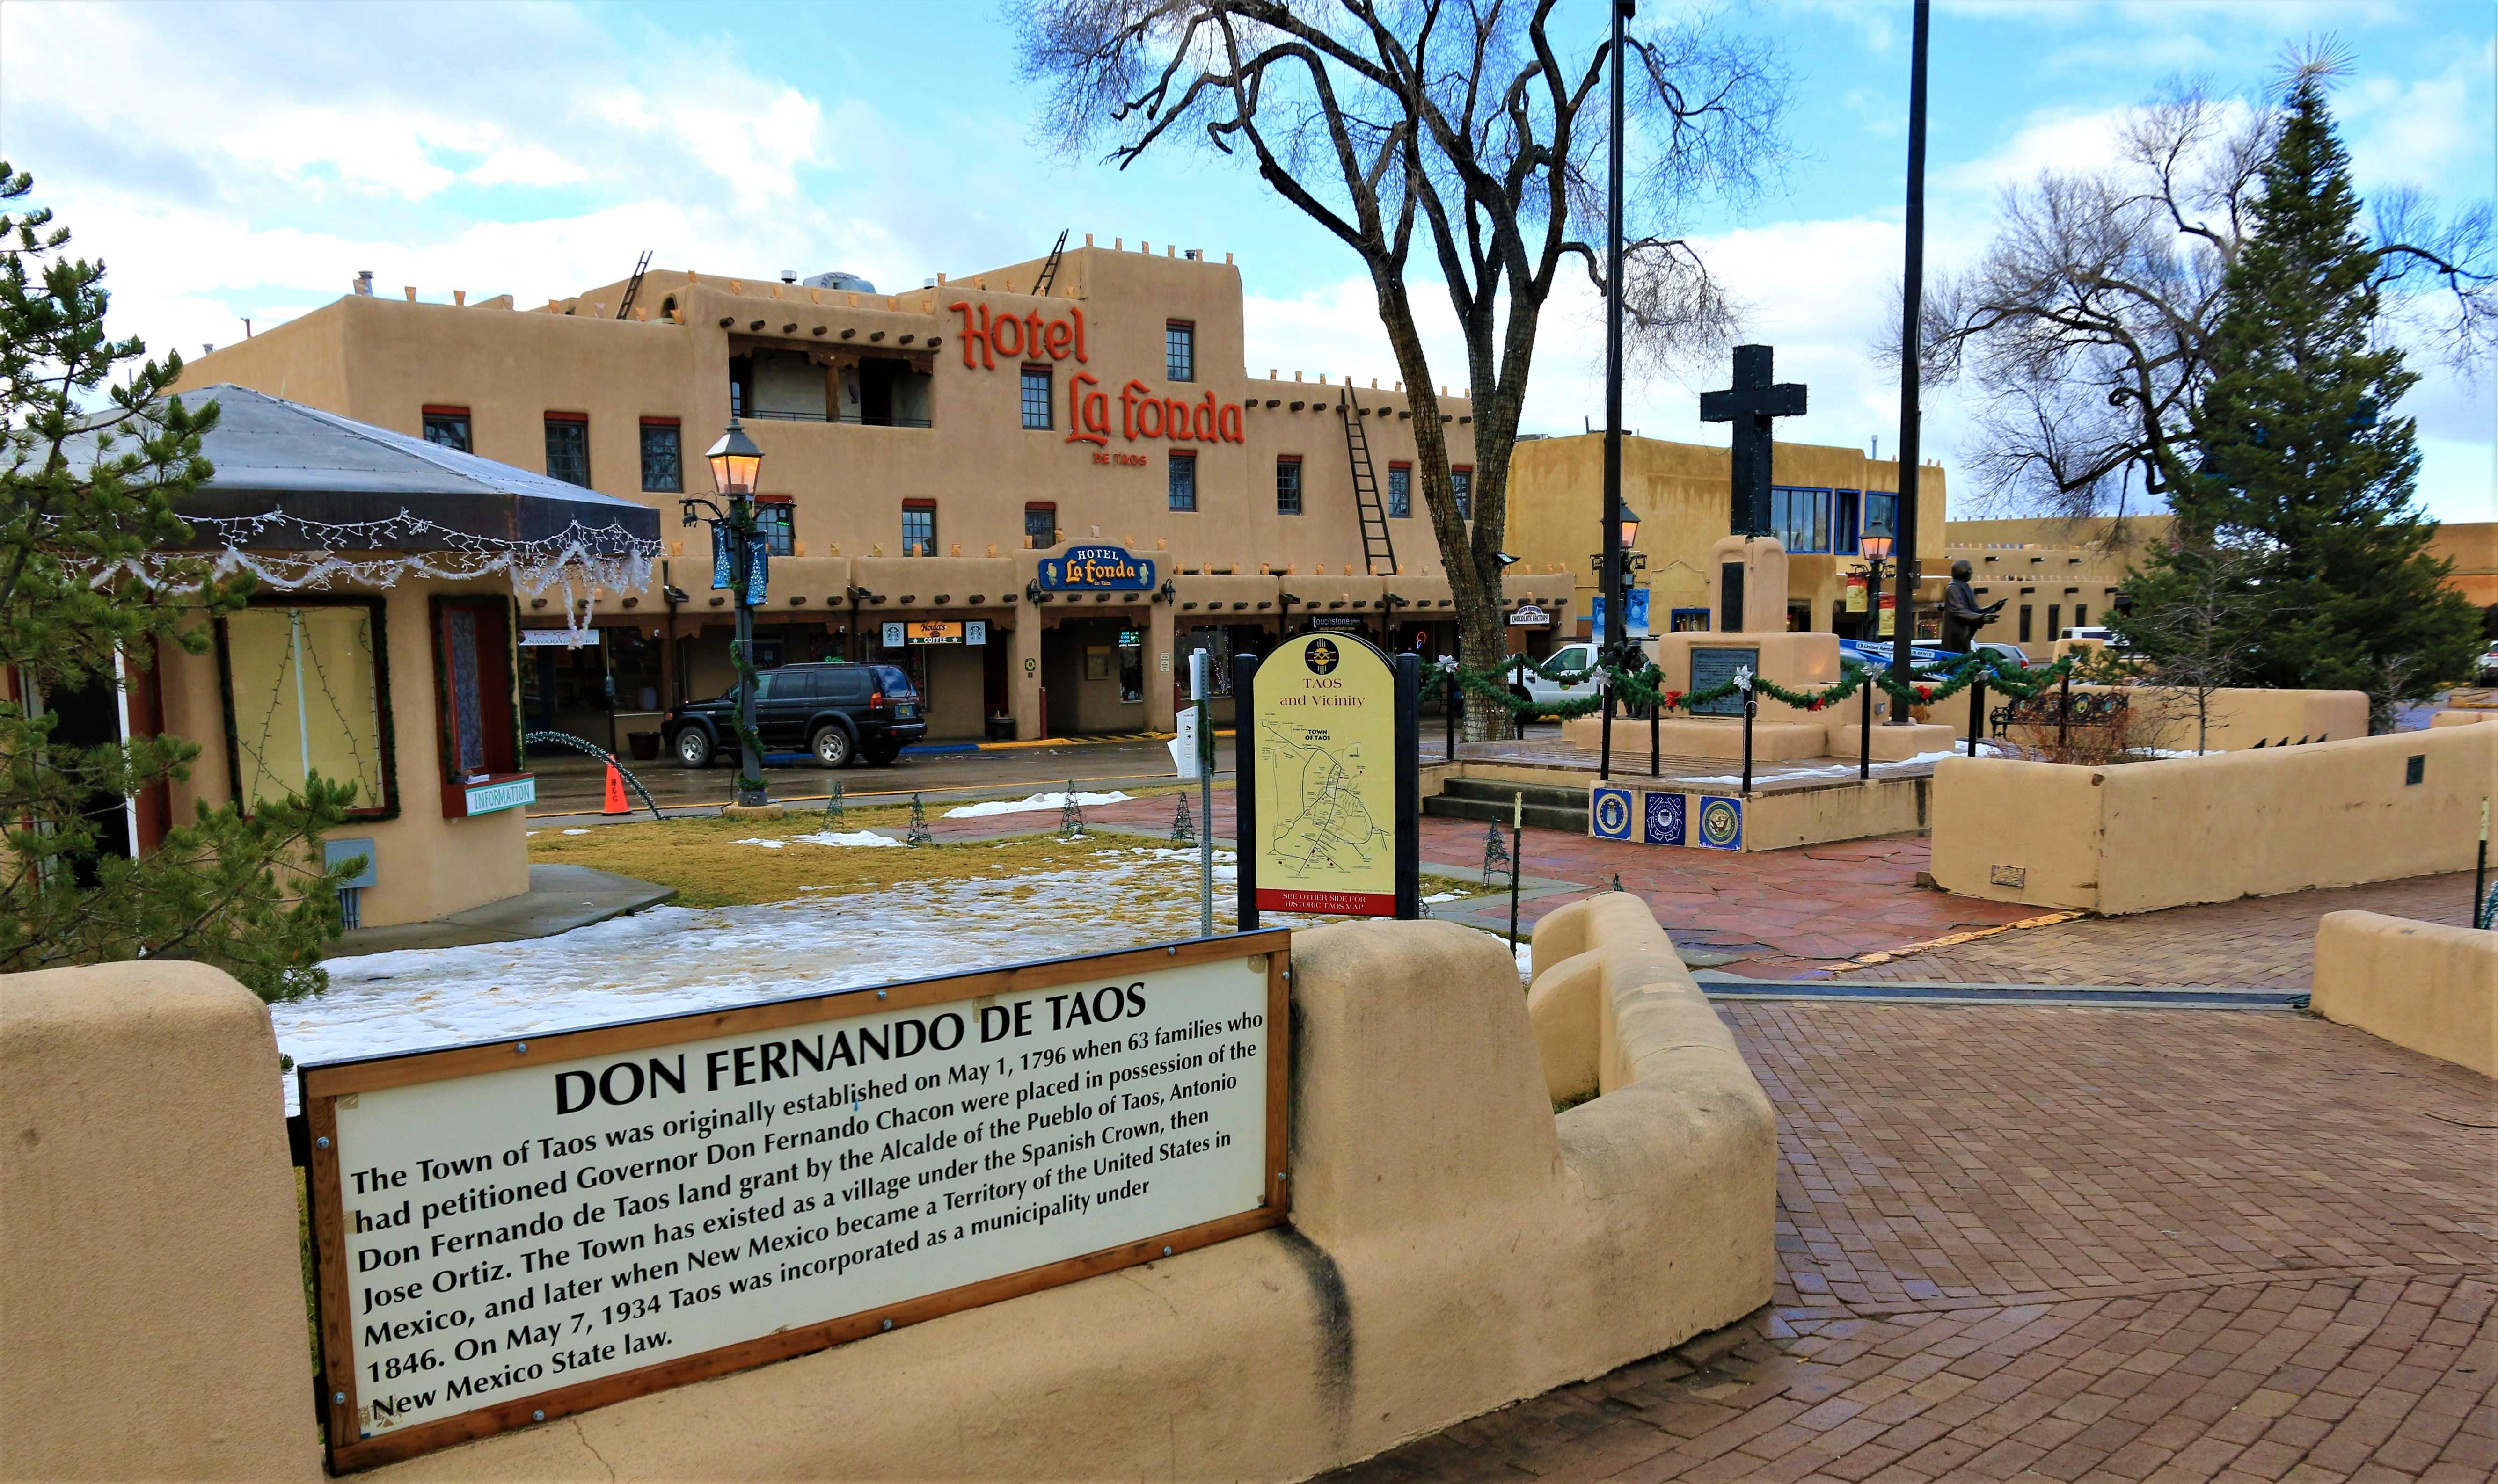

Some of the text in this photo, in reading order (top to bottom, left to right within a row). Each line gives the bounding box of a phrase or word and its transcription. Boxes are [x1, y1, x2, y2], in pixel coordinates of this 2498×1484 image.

[949, 301, 1088, 370] Hotel
[1066, 372, 1111, 446] La
[1093, 453, 1110, 465] DE
[1065, 559, 1083, 583] La
[1077, 549, 1119, 560] HOTEL
[1313, 616, 1350, 627] touchstone
[1280, 695, 1365, 708] and Vicinity
[1303, 678, 1342, 689] TAOS
[474, 784, 530, 809] INFORMATION
[554, 981, 1146, 1116] DON FERNANDO DE TAOS
[350, 1011, 1263, 1194] The Town of Taos was originally established on May 1, 1796 when 63 families who
[355, 1041, 1256, 1234] had petitioned Governor Don Fernando Chacon were placed in possession of the
[358, 1077, 1237, 1273] Don Fernando de Taos land grant by the Alcalde of the Pueblo of Taos, Antonio
[363, 1110, 1208, 1315] Jose Ortiz. The Town has existed as a village under the Spanish Crown, then
[365, 1134, 1230, 1347] Mexico, and later when New Mexico became a Territory of the United States in
[367, 1179, 1149, 1383] 1846. On May 7, 1934 Taos was incorporated as a municipality under
[371, 1331, 672, 1420] New Mexico State law.
